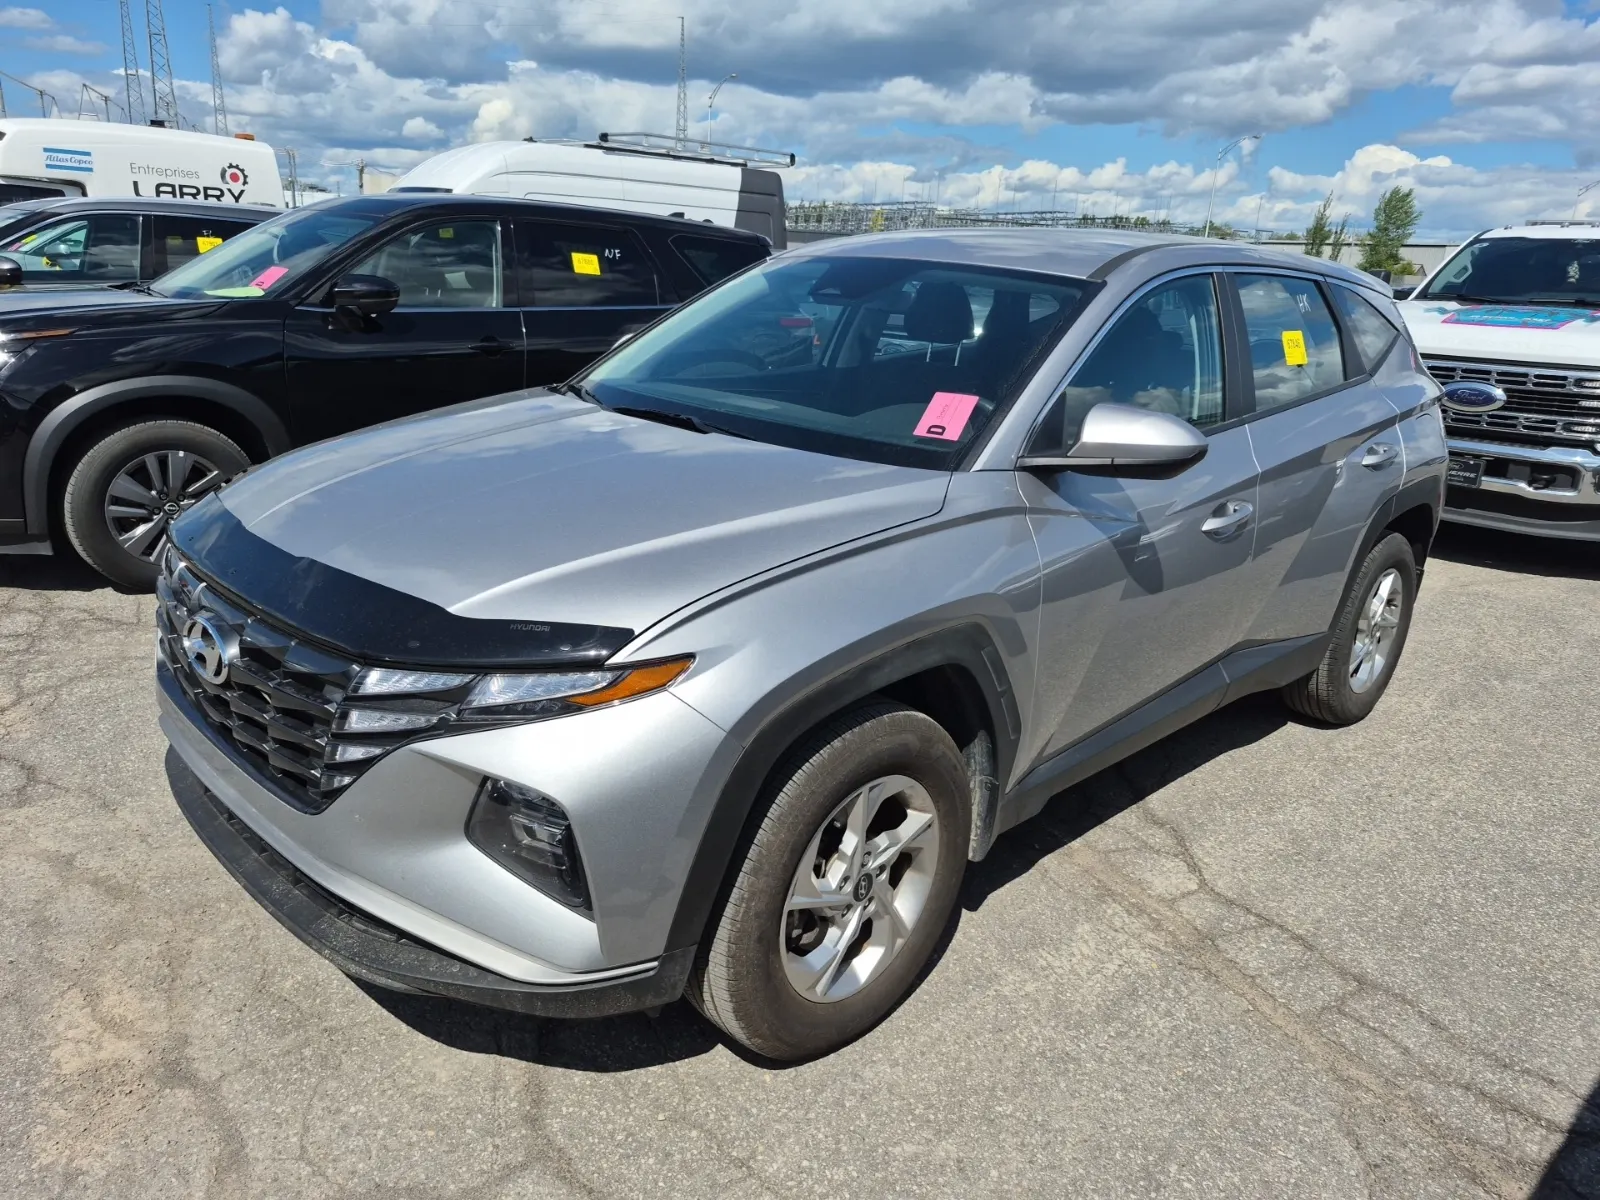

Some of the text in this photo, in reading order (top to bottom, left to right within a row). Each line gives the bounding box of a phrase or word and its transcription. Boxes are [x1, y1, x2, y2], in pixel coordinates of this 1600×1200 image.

[45, 155, 93, 165] Atlas Copco
[129, 162, 200, 179] Entreprises
[132, 180, 246, 203] LARRY
[925, 424, 947, 436] D
[509, 623, 551, 632] HYUNDAI
